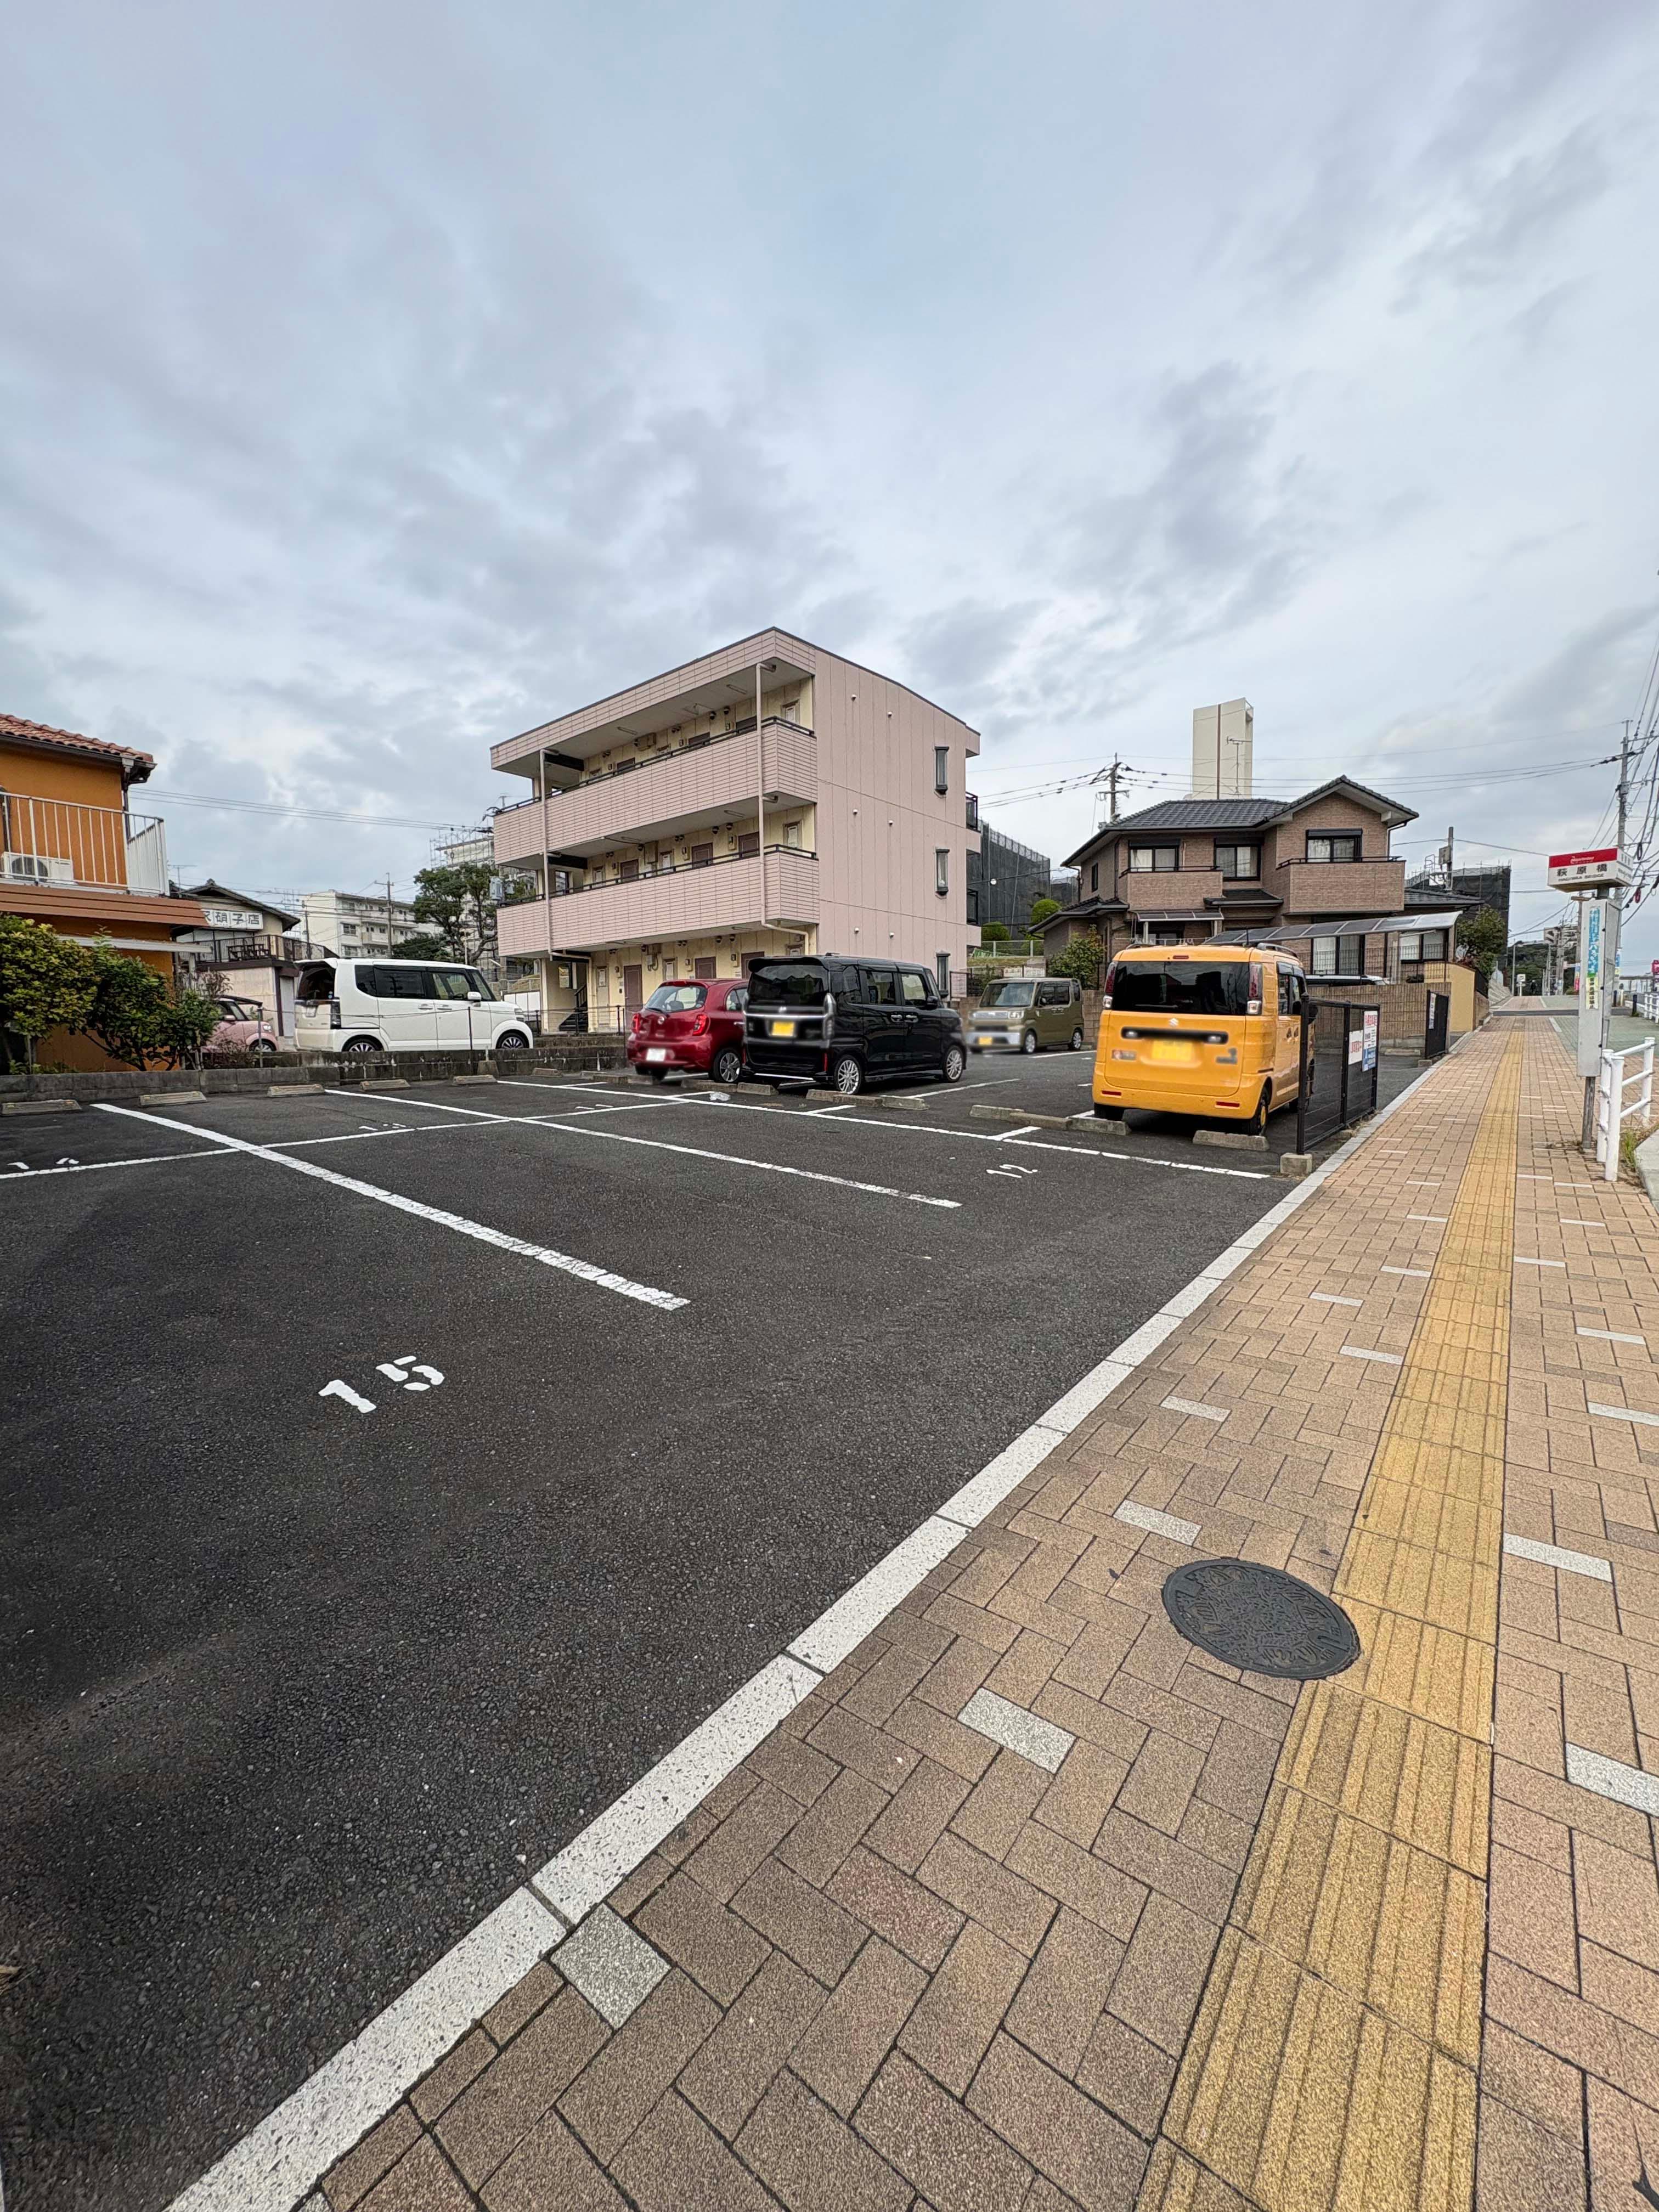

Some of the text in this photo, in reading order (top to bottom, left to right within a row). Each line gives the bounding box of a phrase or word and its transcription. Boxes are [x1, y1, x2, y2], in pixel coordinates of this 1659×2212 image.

[1557, 864, 1607, 876] 萩原橋
[986, 1164, 1038, 1178] 12
[318, 1355, 445, 1414] 15
